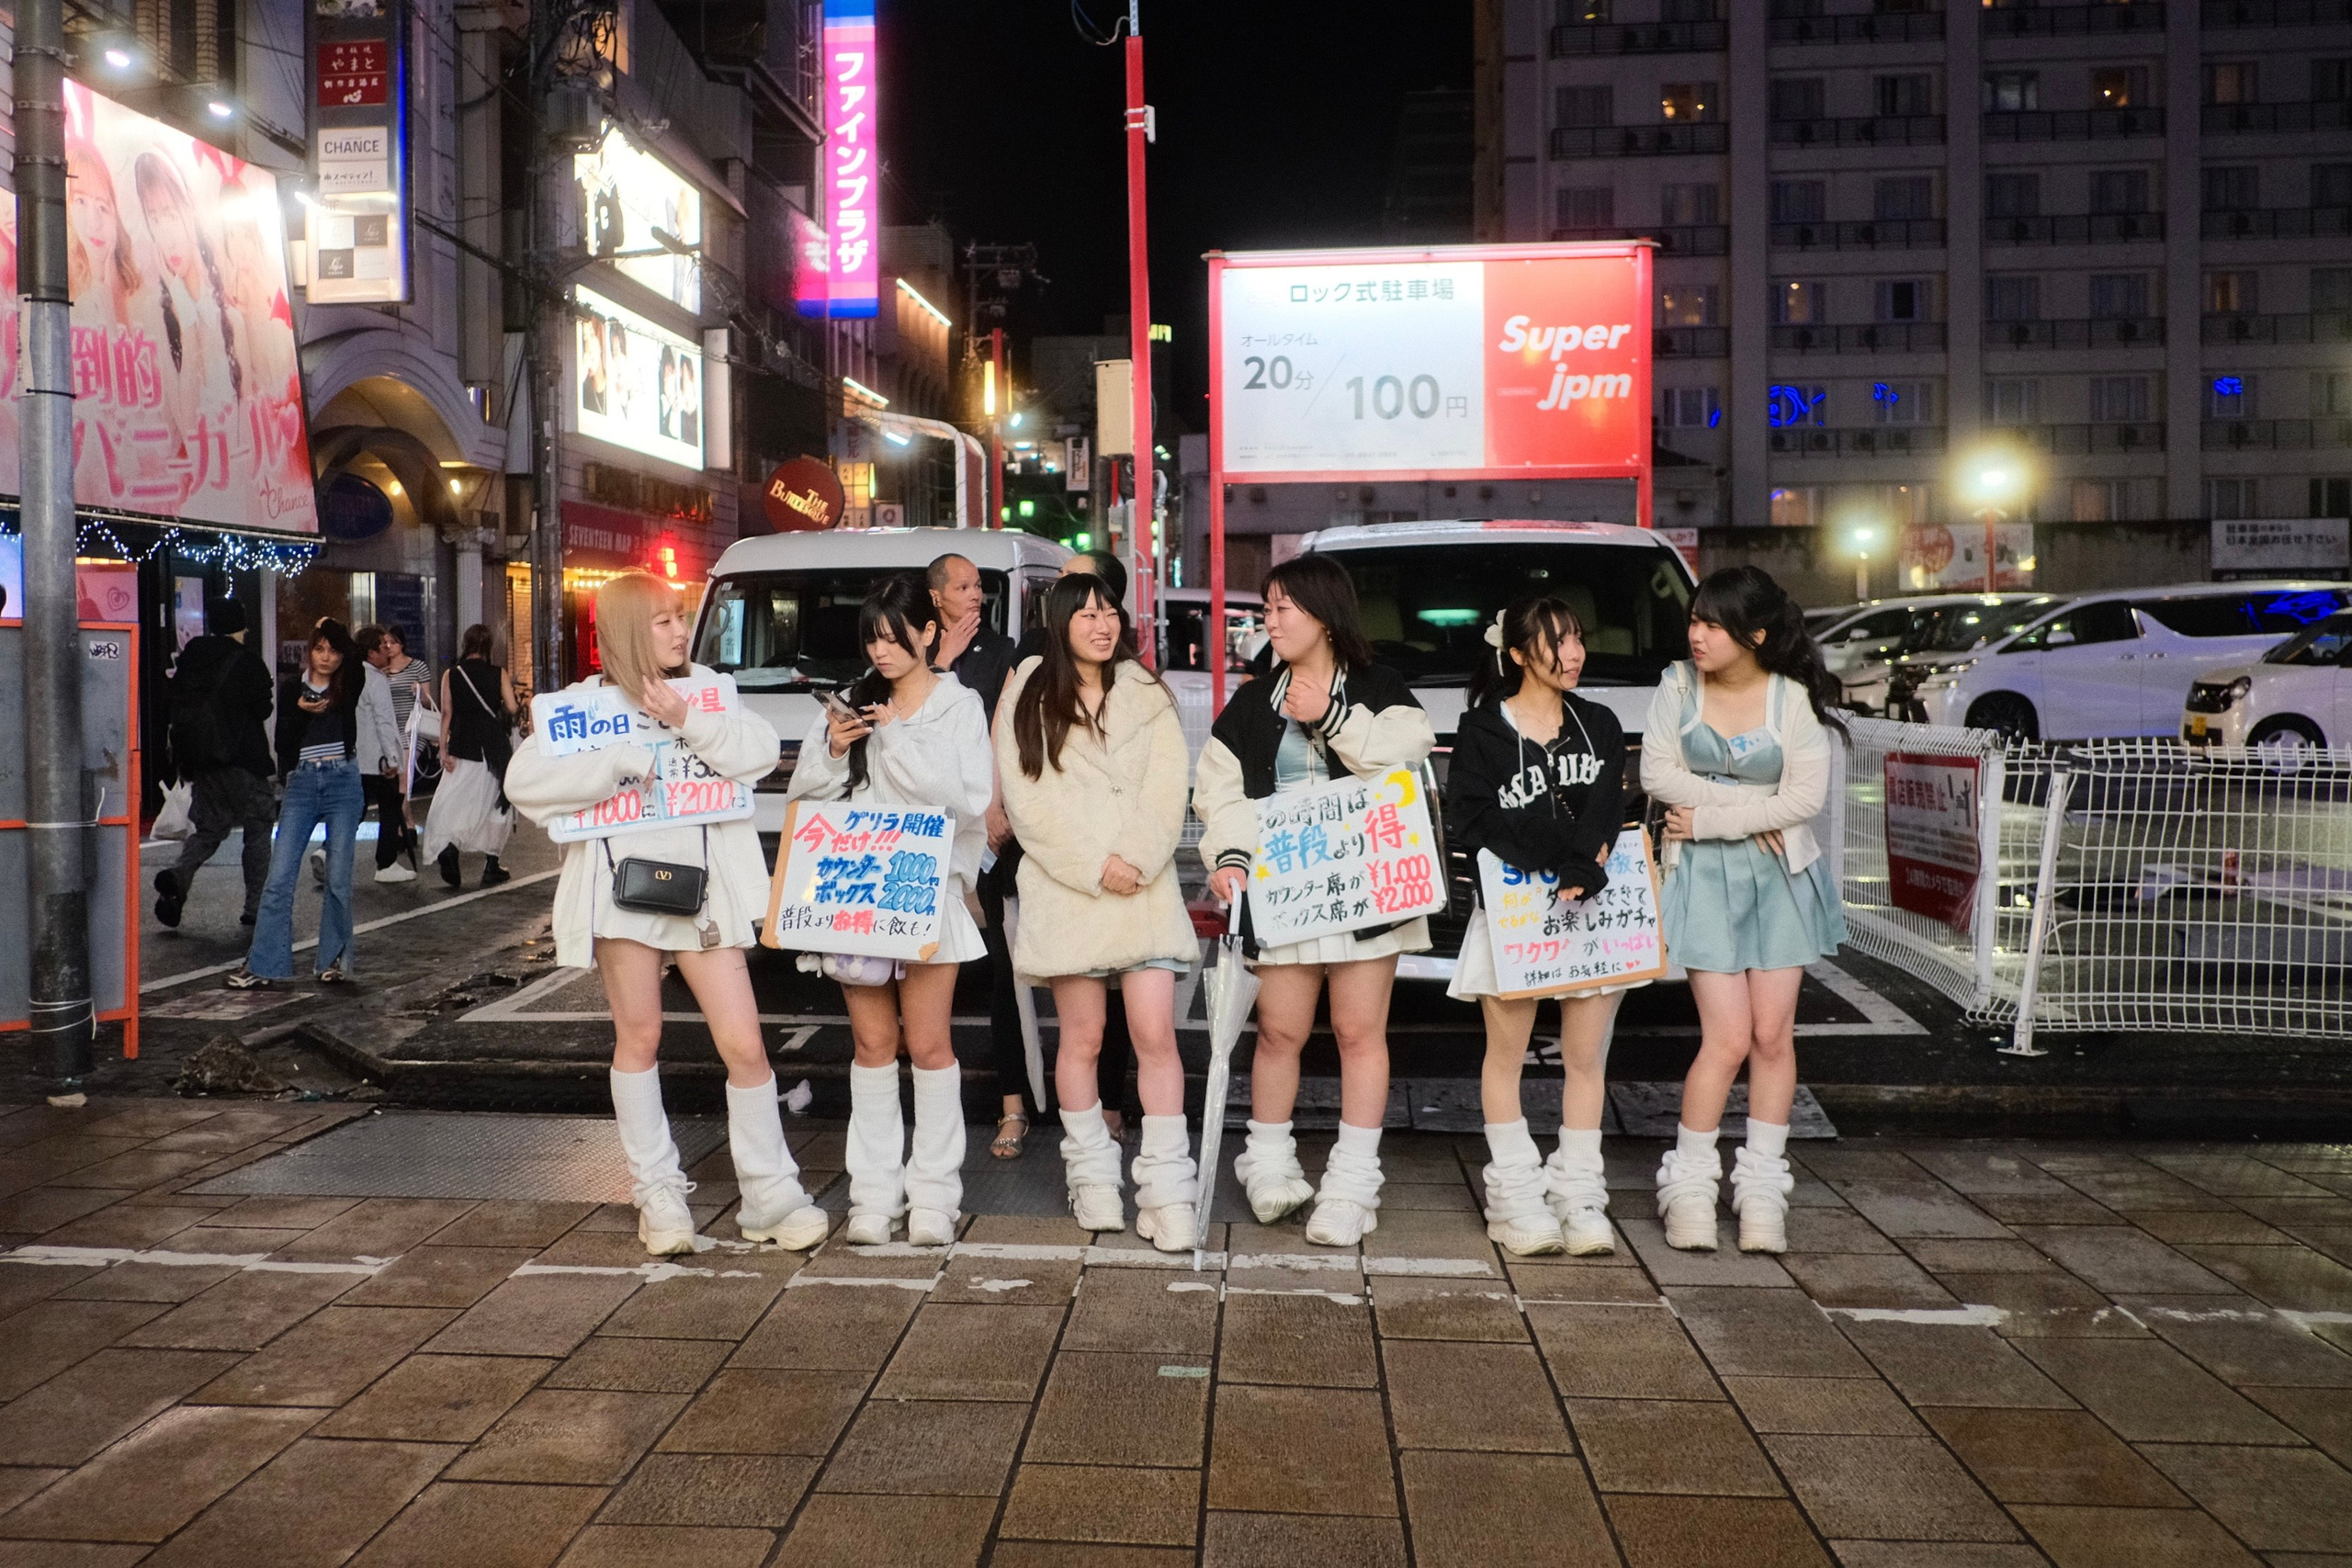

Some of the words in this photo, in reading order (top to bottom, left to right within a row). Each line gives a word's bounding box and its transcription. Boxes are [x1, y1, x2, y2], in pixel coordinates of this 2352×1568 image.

[332, 57, 375, 72] やまと
[324, 140, 379, 154] CHANCE
[834, 51, 869, 274] ファインプラザ
[1290, 277, 1455, 303] ロック式駐車場
[1240, 333, 1318, 348] オールタイム
[1498, 314, 1633, 362] Super
[1535, 362, 1633, 411] jpm
[259, 474, 311, 521] Chance
[569, 524, 613, 550] SEVENTEEN
[548, 704, 630, 742] 雨の日
[793, 812, 902, 853] 今だけ!!!
[844, 810, 945, 838] ゲリラ開催
[1264, 802, 1407, 874] 普段より得
[816, 853, 883, 881] カウンター
[884, 850, 940, 887] 1000円
[814, 878, 877, 905] ボックス
[877, 882, 936, 916] 2000円
[1543, 907, 1656, 937] お楽しみガチャ
